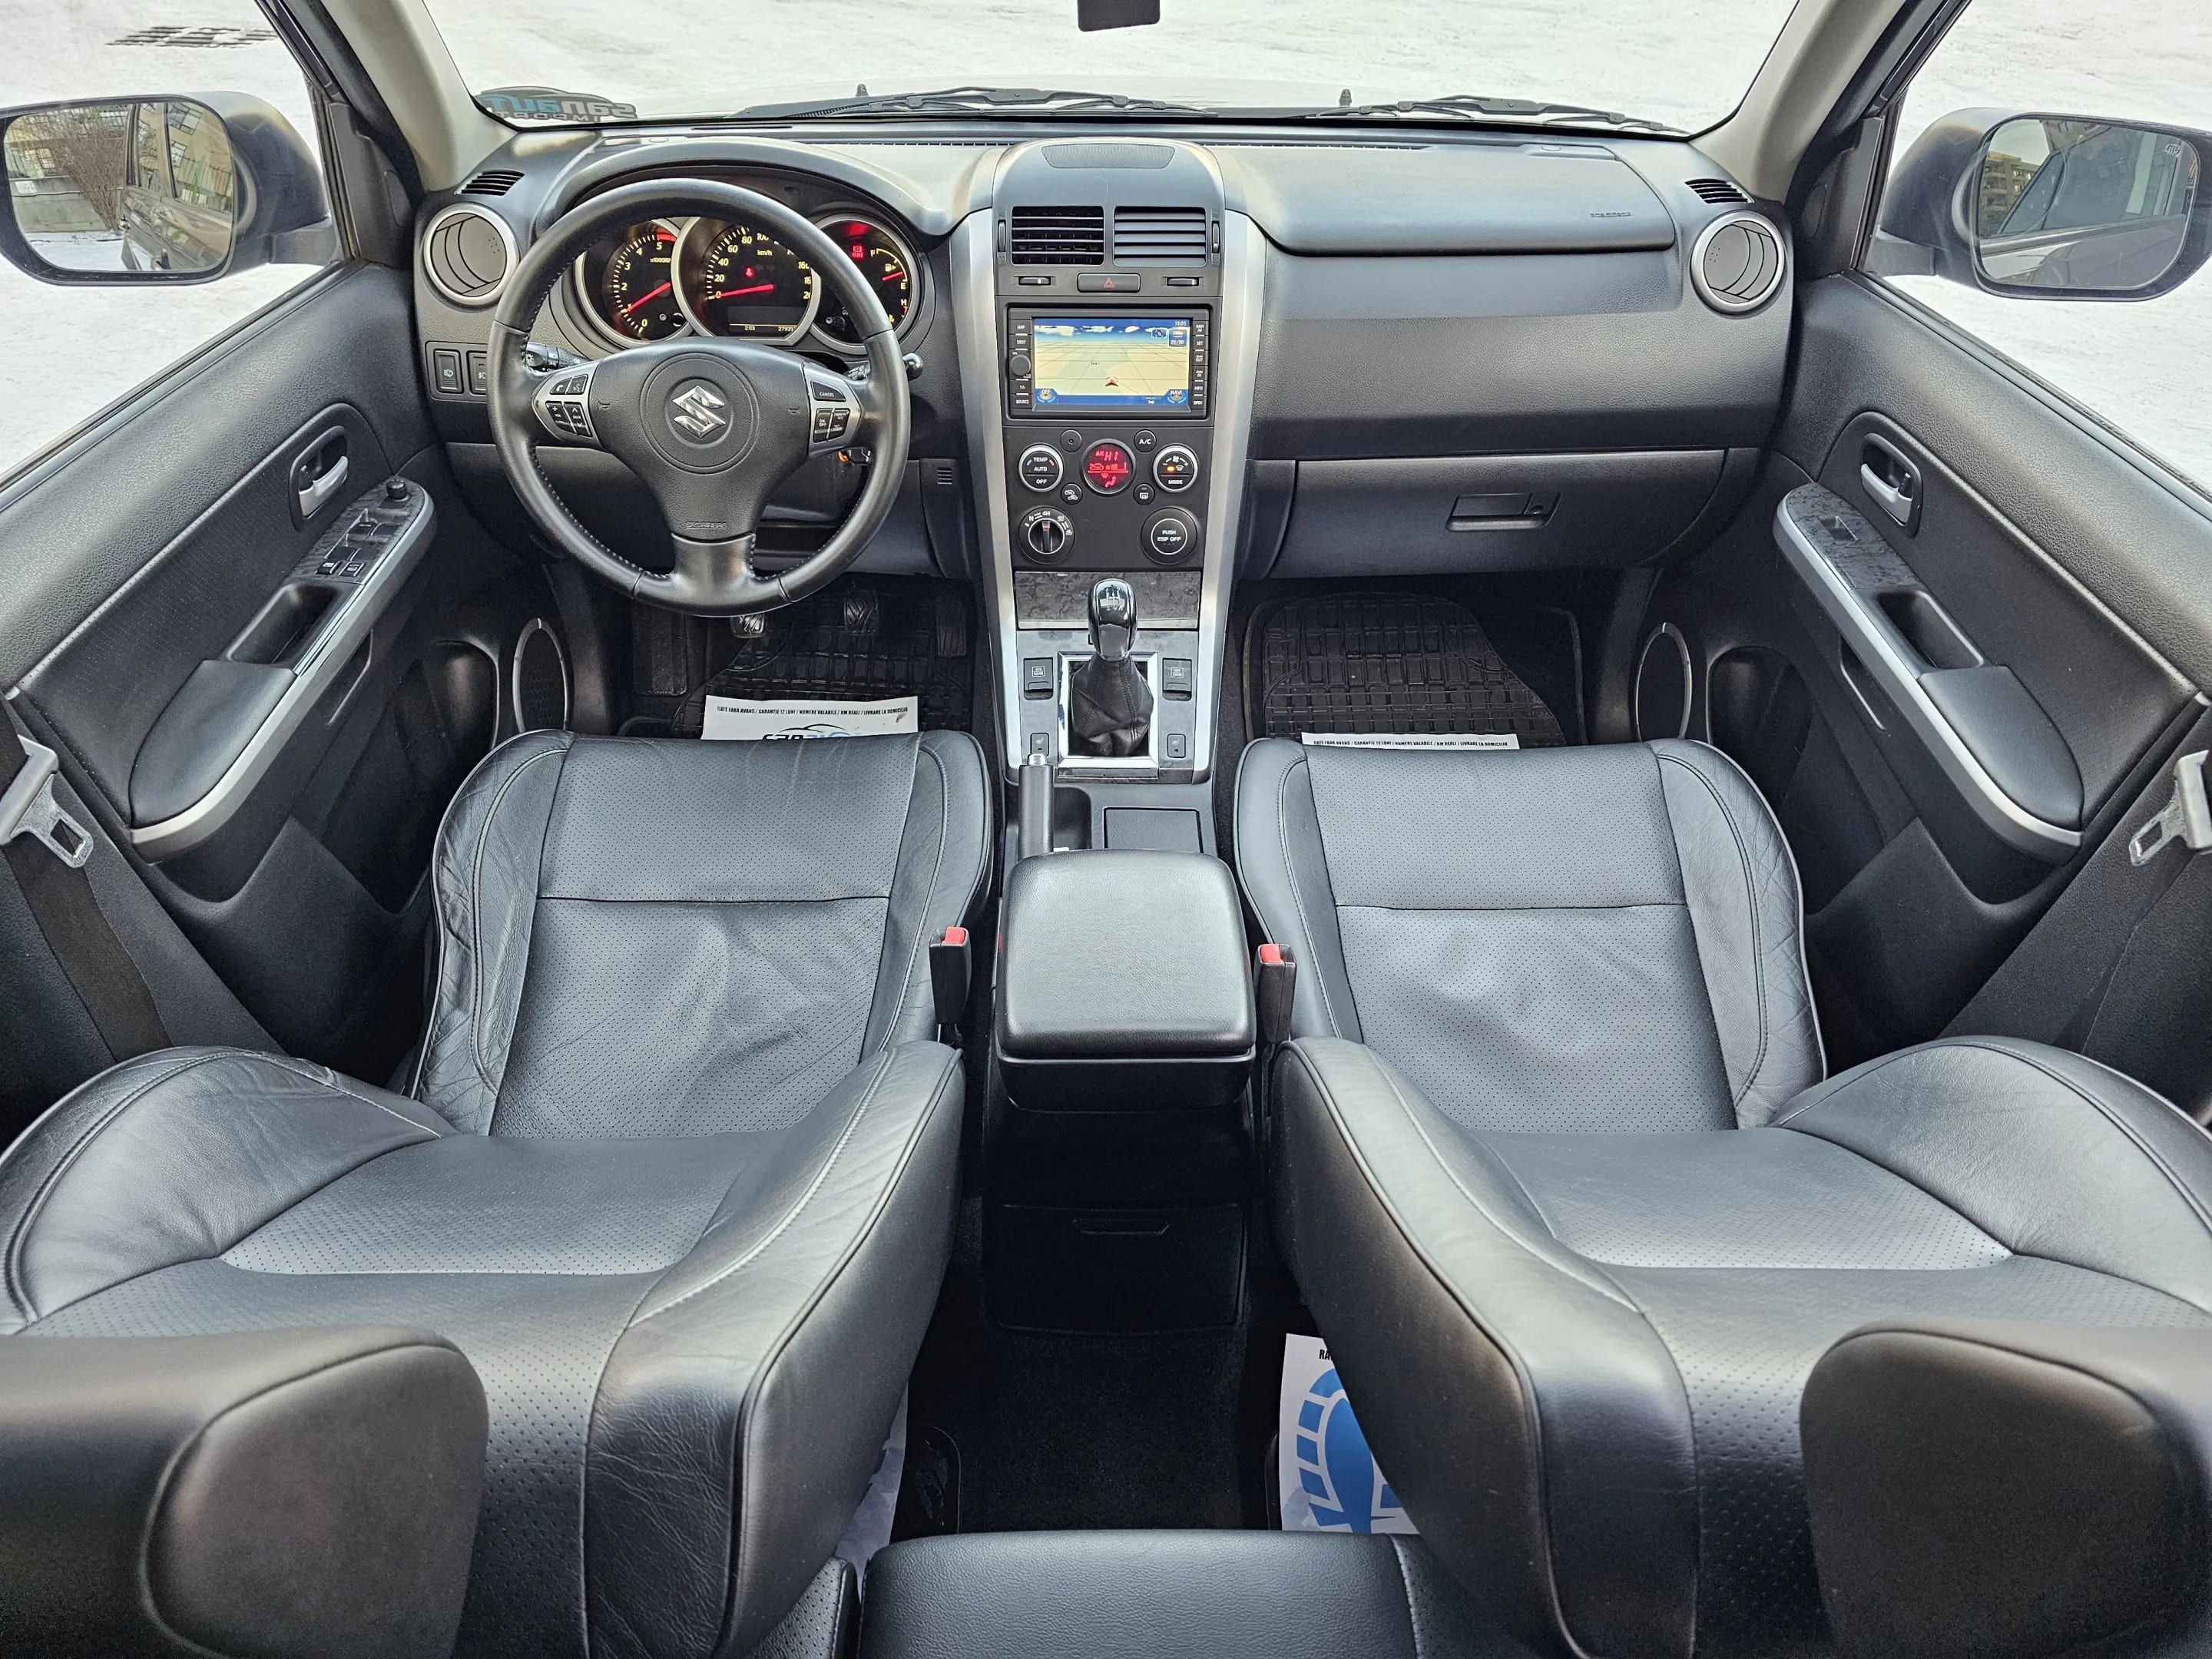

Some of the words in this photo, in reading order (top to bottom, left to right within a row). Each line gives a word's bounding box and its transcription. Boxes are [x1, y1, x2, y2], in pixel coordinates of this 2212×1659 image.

[741, 236, 752, 244] 80
[656, 242, 663, 250] 5
[727, 245, 738, 253] 60
[636, 247, 643, 256] 4
[624, 262, 631, 270] 3
[717, 258, 729, 267] 40
[714, 274, 724, 283] 20
[621, 283, 628, 291] 2
[641, 319, 648, 327] 0
